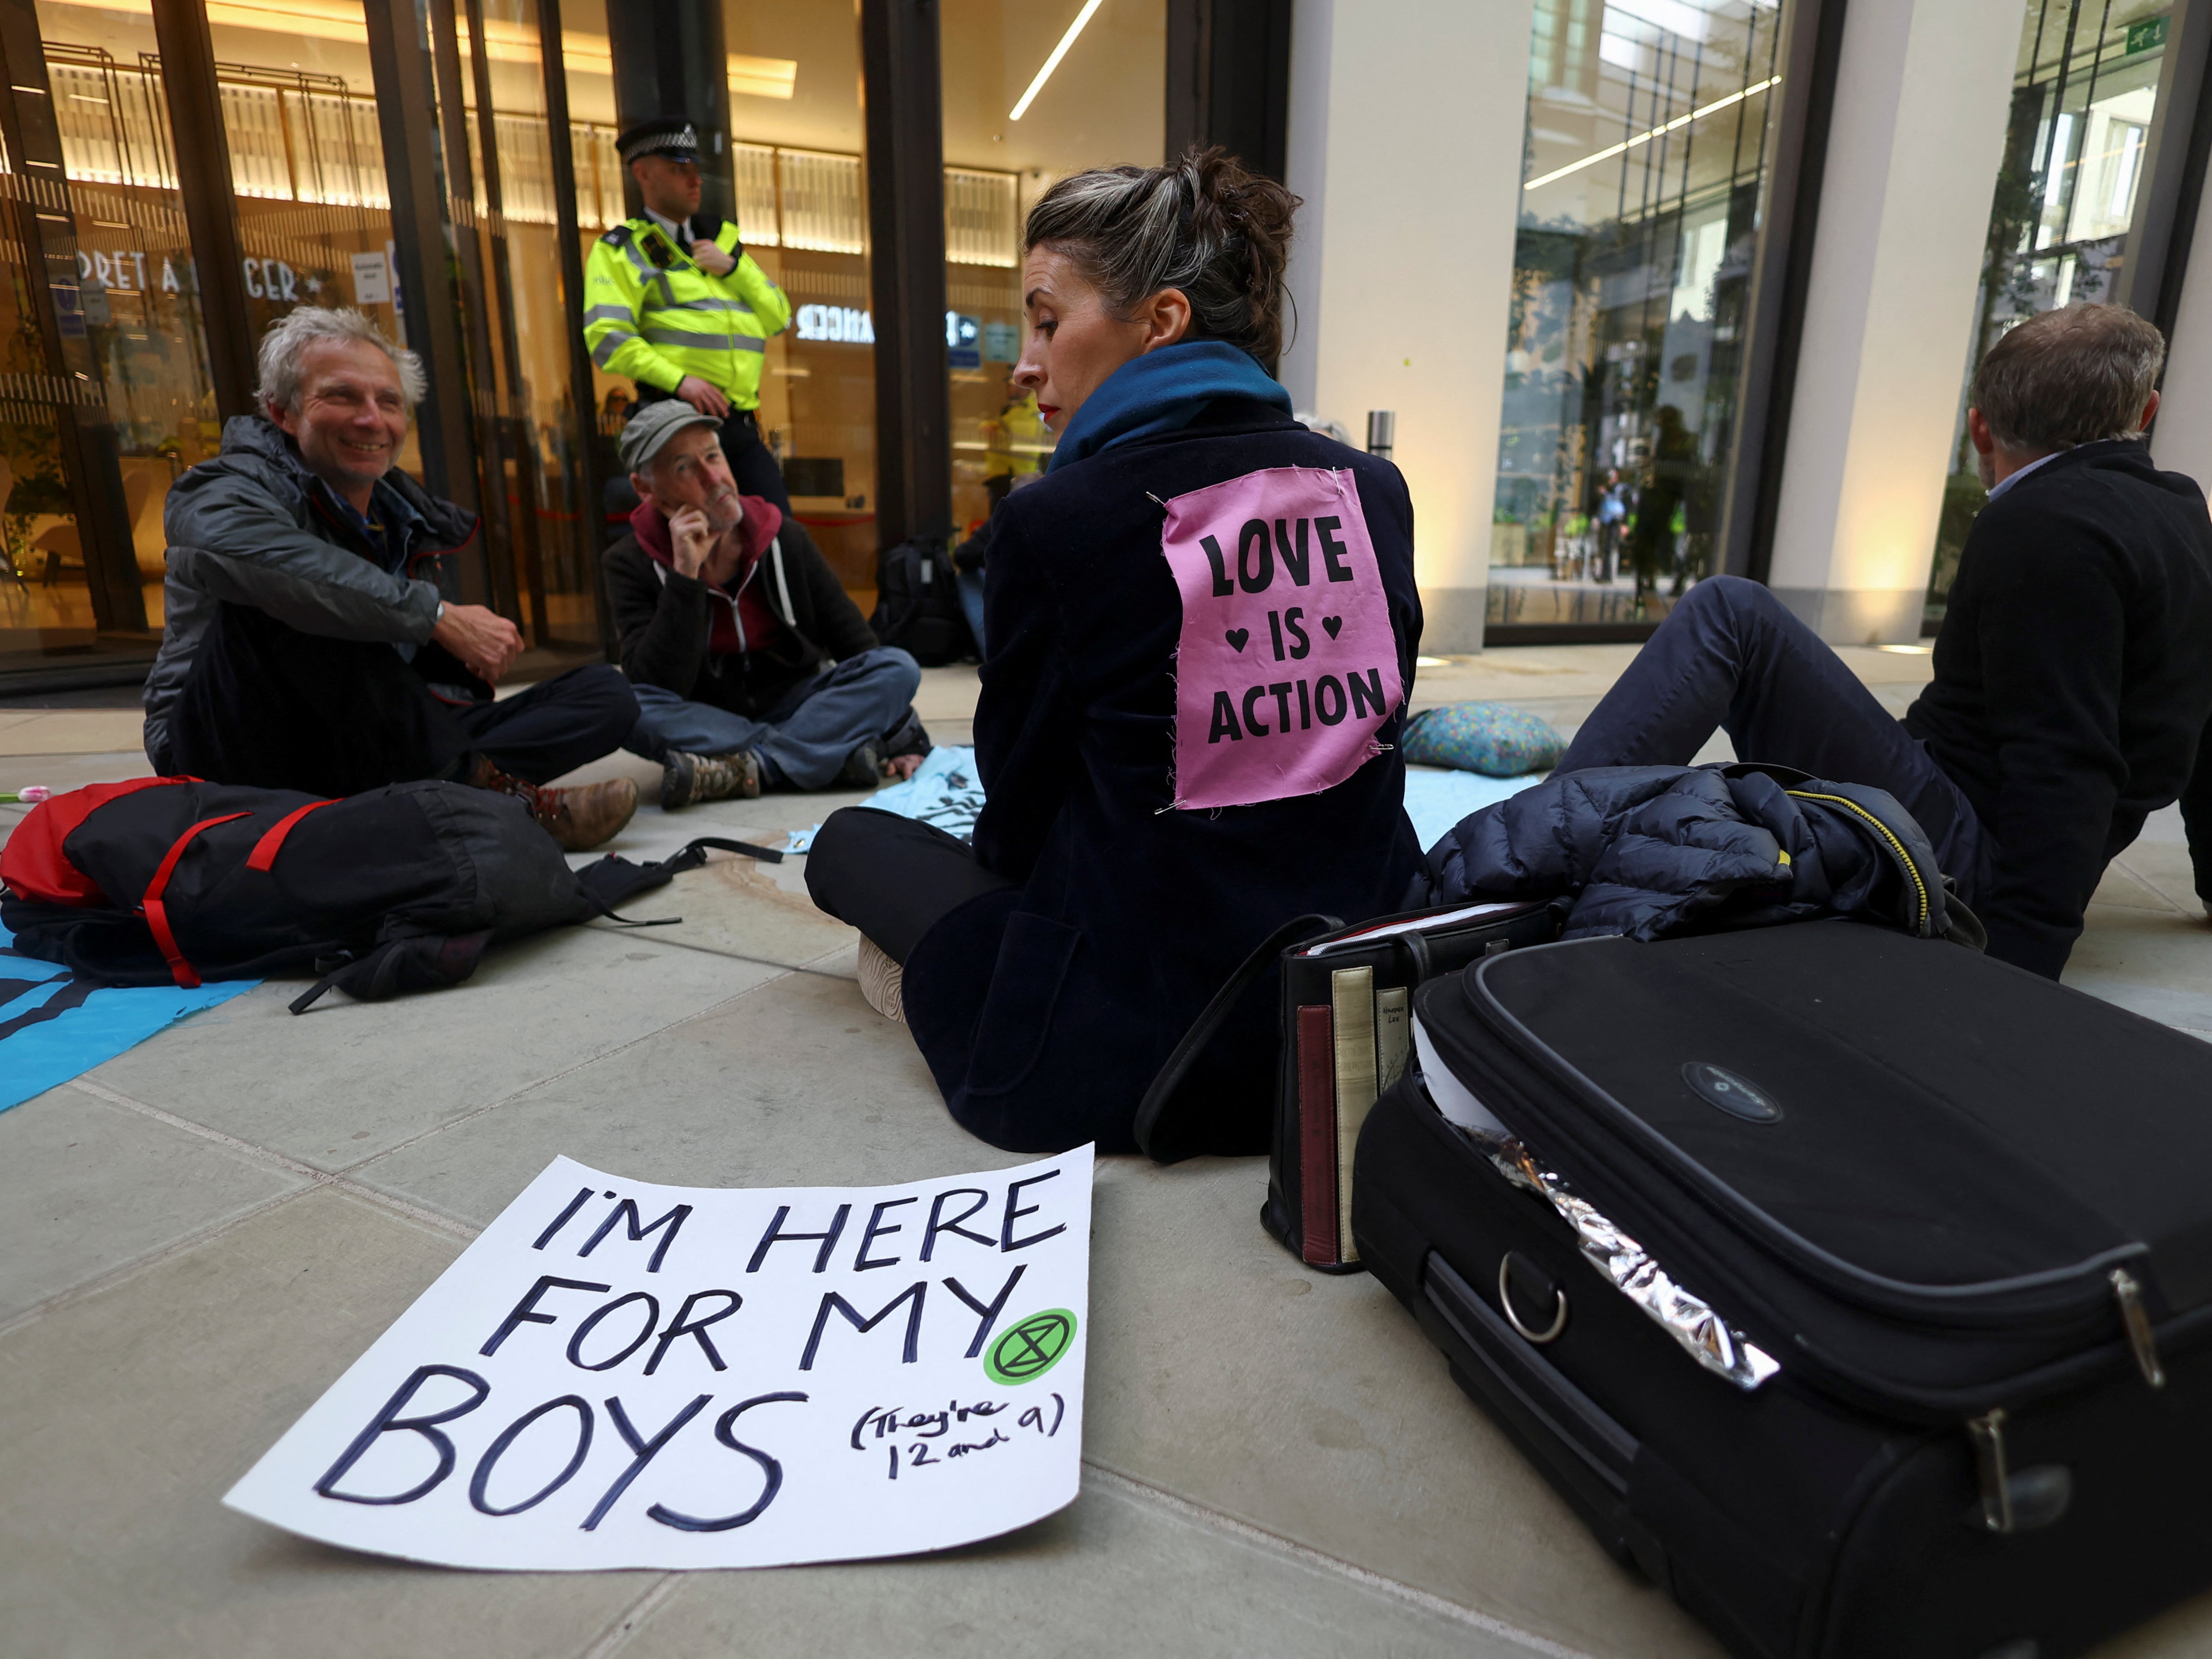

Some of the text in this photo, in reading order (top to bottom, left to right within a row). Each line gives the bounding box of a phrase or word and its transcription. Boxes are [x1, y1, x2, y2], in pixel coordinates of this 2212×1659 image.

[78, 250, 145, 291] PRET
[162, 256, 180, 292] A
[1199, 516, 1353, 597] LOVE
[1268, 607, 1311, 661] IS
[1208, 668, 1386, 744] ACTION
[1383, 1006, 1404, 1014] HARPER
[1388, 1015, 1400, 1023] LEE
[531, 1169, 1067, 1273] I'M HERE
[479, 1263, 1028, 1376] FOR MY
[312, 1363, 809, 1532] BOYS
[889, 1443, 941, 1480] 12
[948, 1427, 1010, 1458] and
